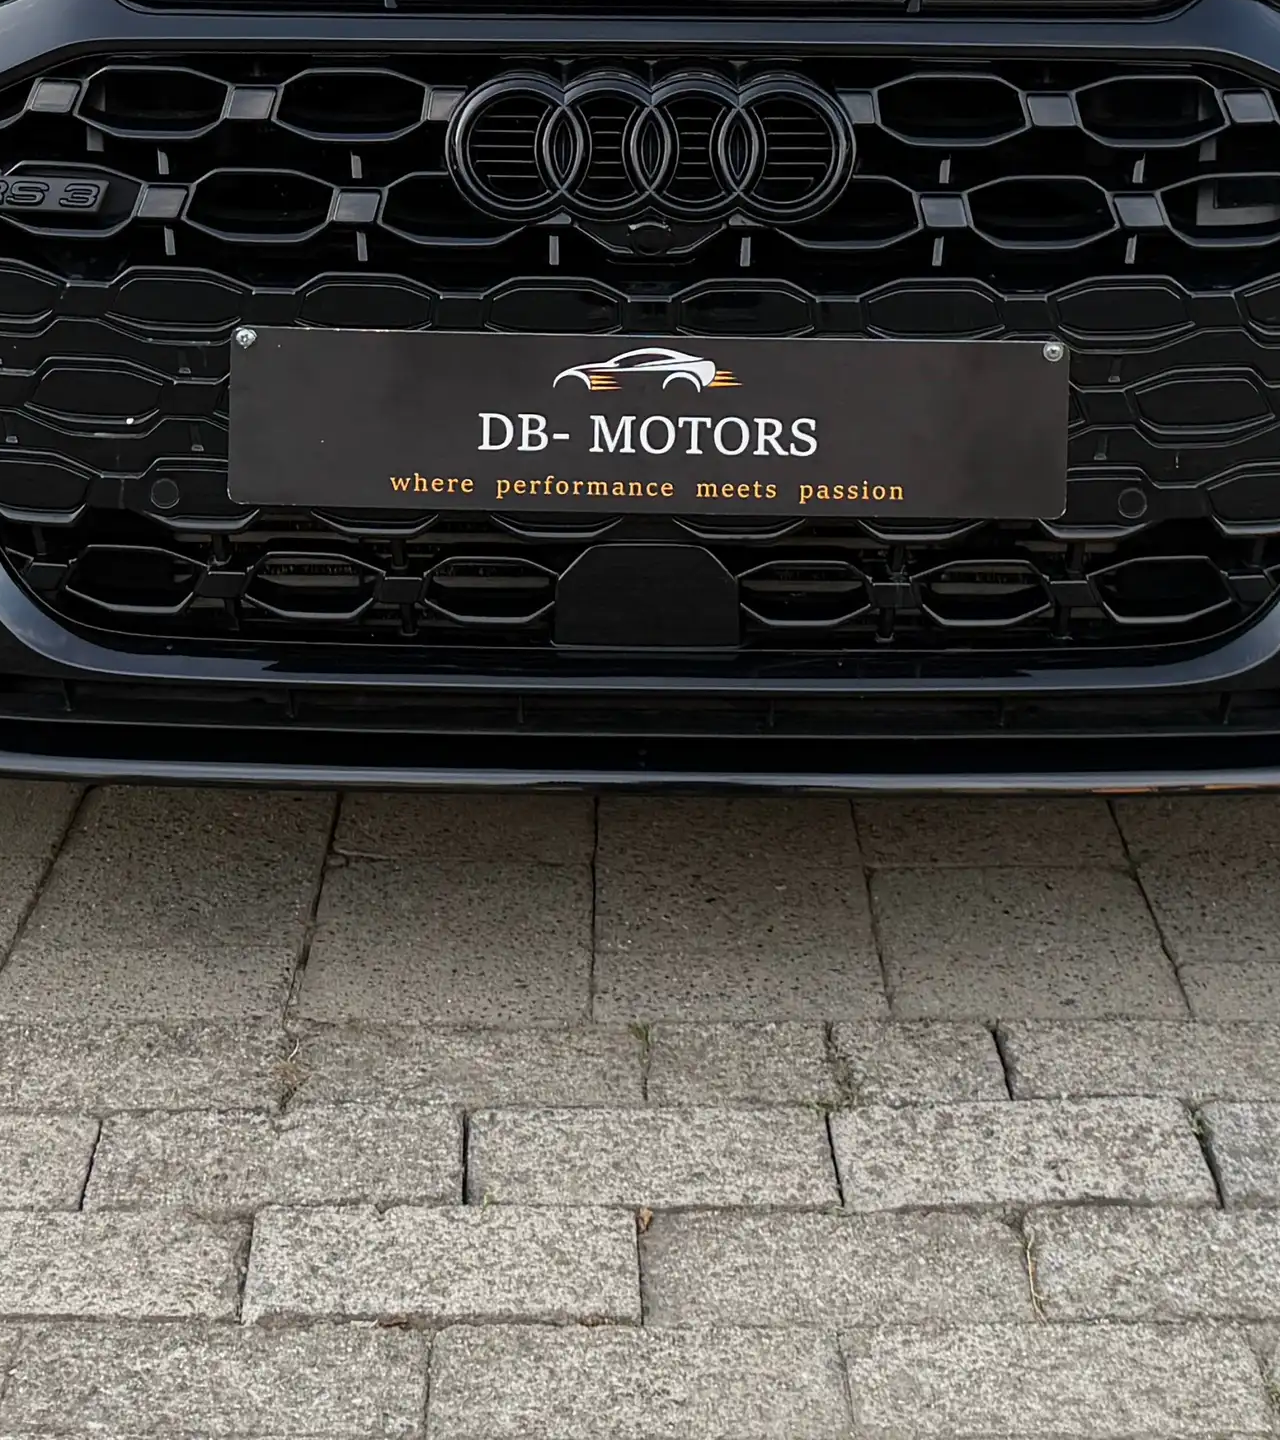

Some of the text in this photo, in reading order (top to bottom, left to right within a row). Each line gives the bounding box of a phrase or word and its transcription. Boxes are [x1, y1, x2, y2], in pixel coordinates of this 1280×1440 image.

[59, 180, 100, 207] 3
[477, 412, 818, 457] DB- MOTORS
[390, 473, 905, 505] where performance meets passion
